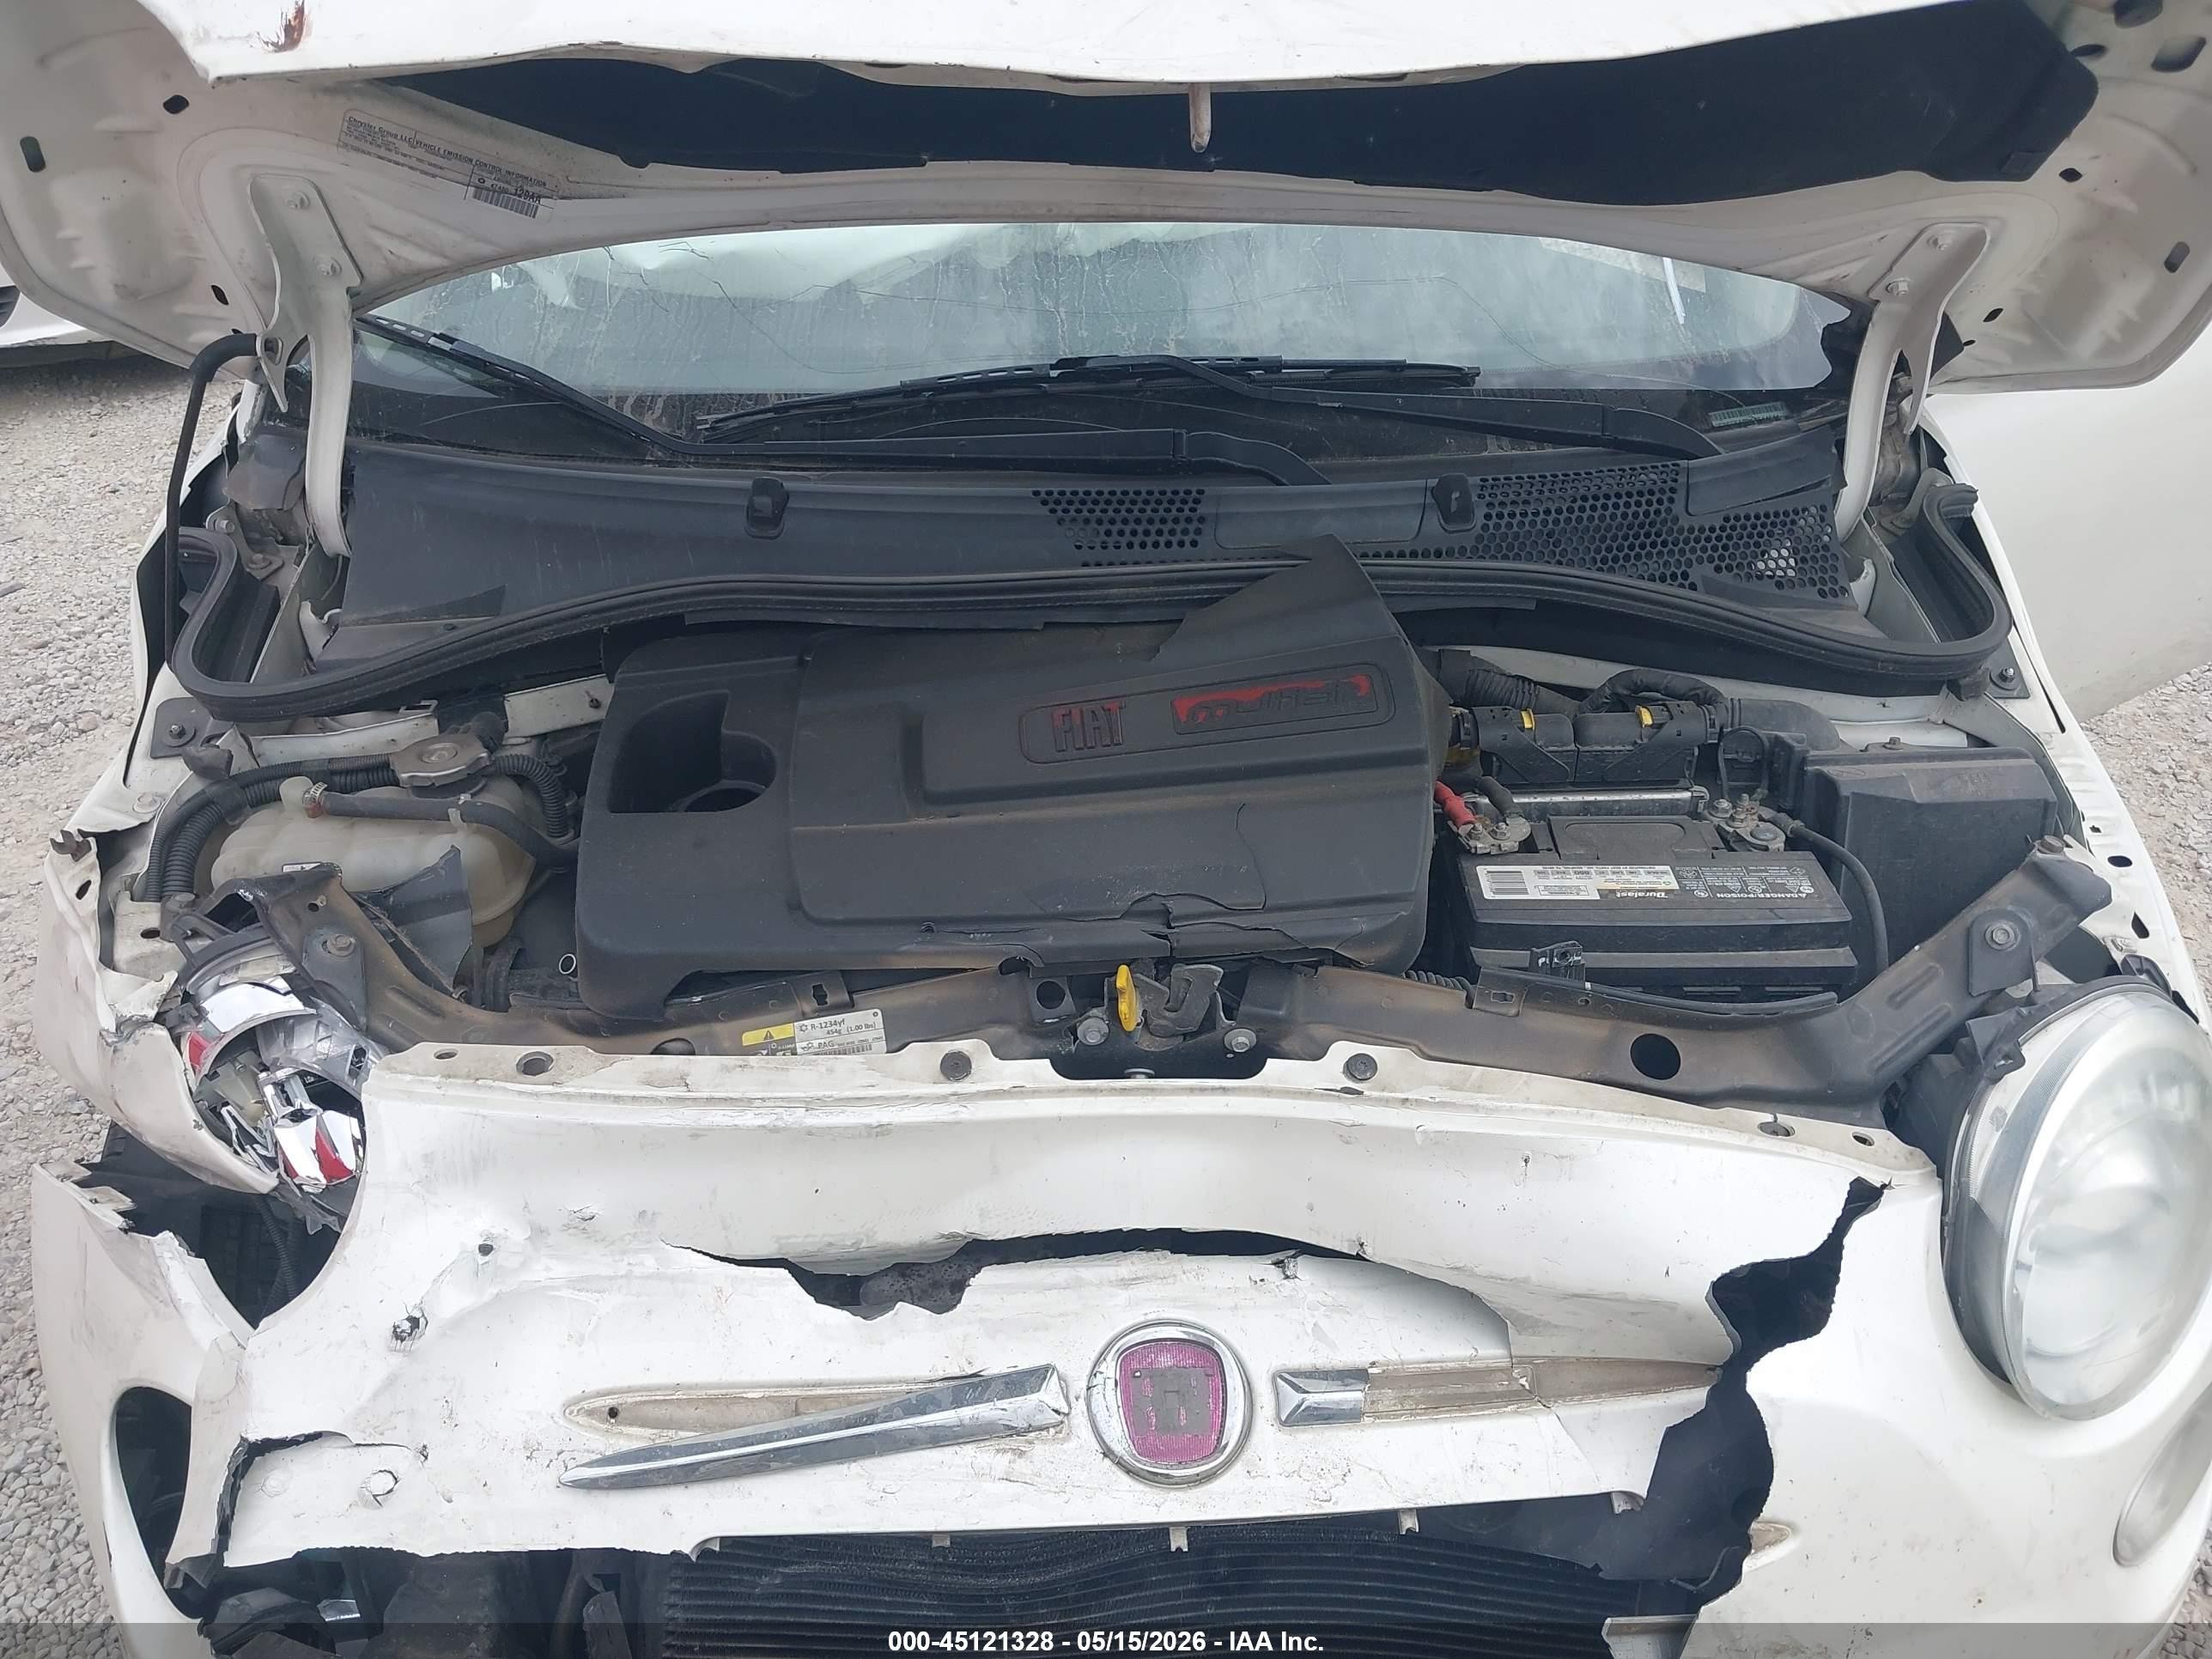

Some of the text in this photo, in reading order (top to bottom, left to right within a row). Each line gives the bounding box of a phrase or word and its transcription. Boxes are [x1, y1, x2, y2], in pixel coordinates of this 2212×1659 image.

[349, 116, 376, 131] Chrysler
[378, 126, 398, 139] Group
[401, 134, 413, 143] LLC
[416, 139, 441, 152] VEHICLE
[442, 149, 474, 164] EMISSION
[475, 159, 502, 173] CONTROL
[505, 169, 547, 187] INFORMATION
[1052, 702, 1126, 753] FIAT
[810, 1018, 846, 1031] R-1234yf
[826, 1021, 876, 1036] 454g (1.00 lbs)
[817, 1040, 835, 1049] PAG
